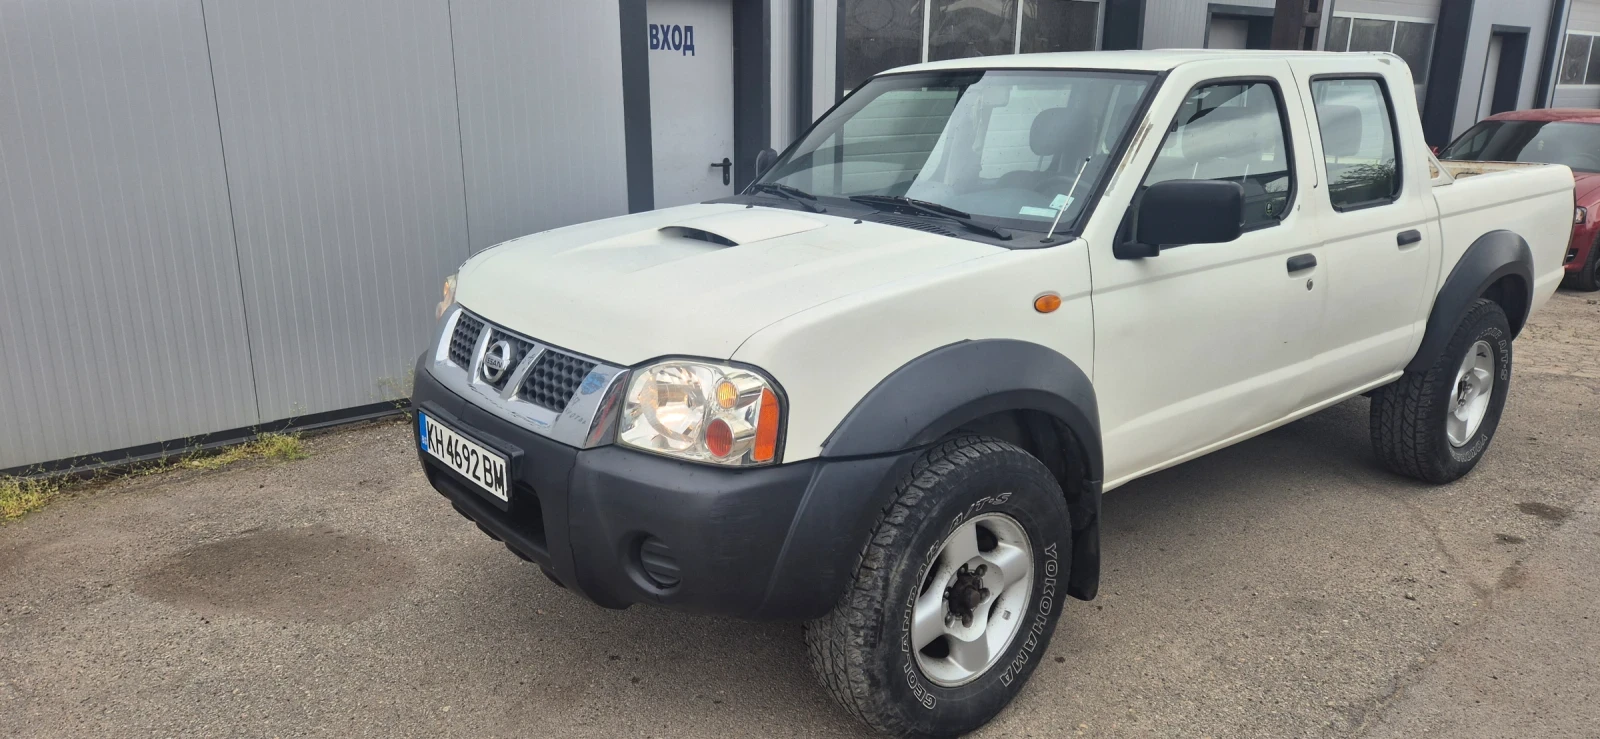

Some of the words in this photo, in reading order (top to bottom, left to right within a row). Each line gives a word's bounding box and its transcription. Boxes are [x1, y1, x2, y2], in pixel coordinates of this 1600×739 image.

[649, 24, 695, 56] ВХОД
[902, 540, 939, 709] GEOLANDAR
[1000, 542, 1058, 687] YOKOHAMA
